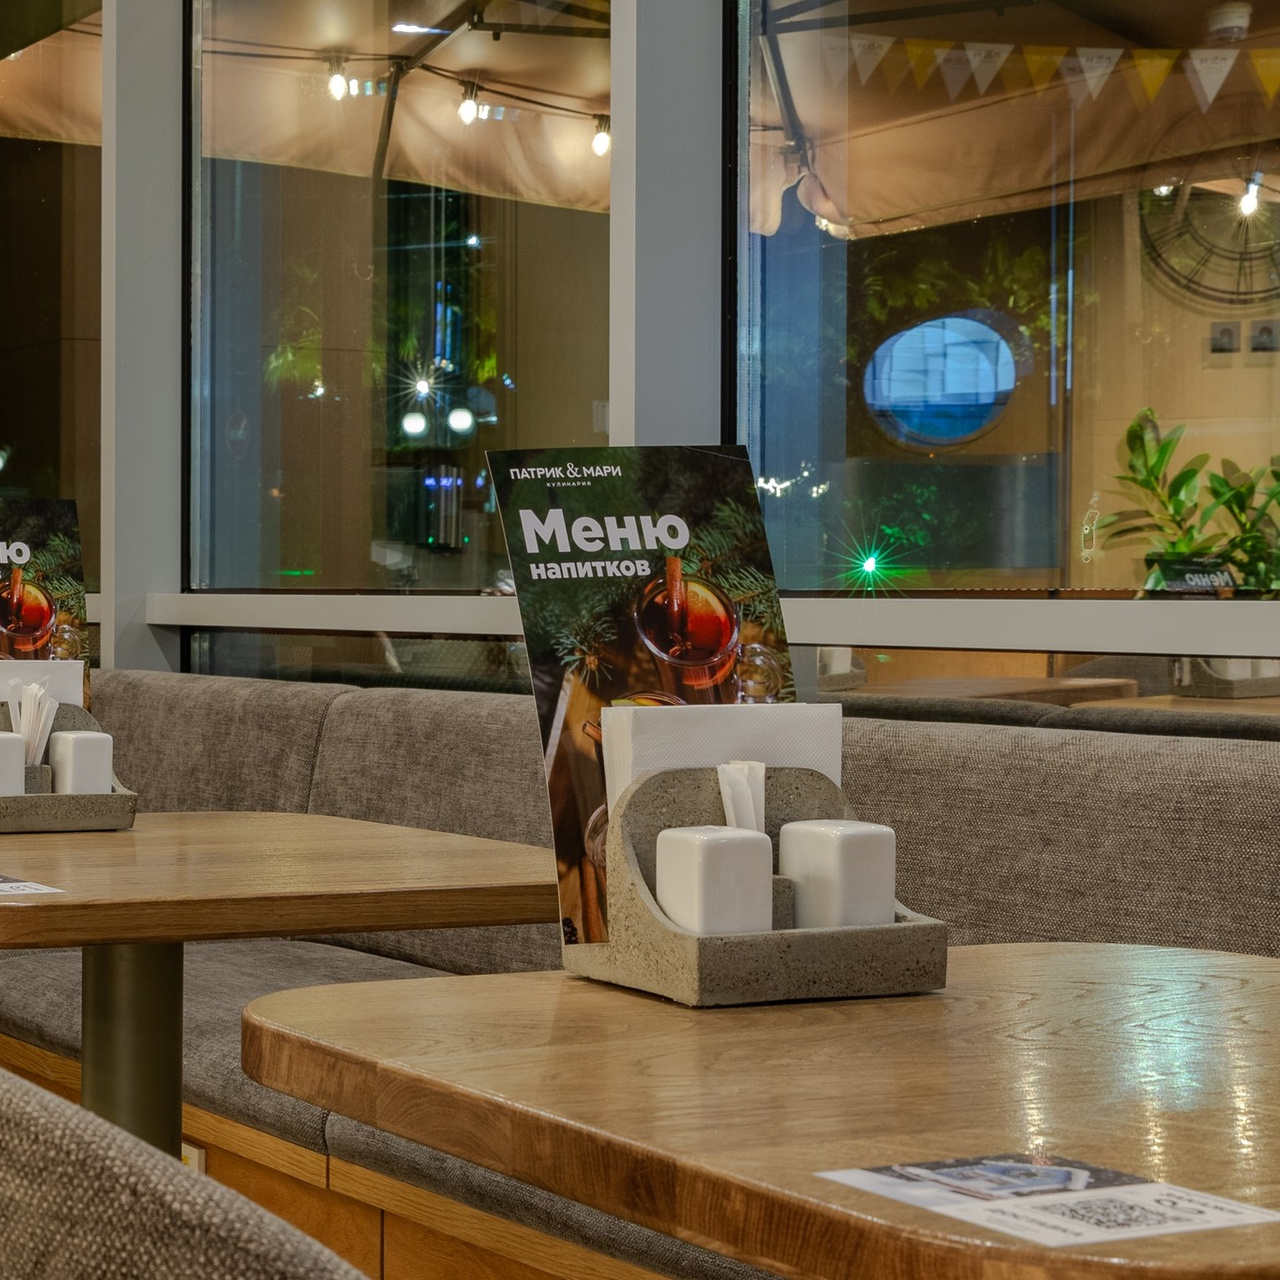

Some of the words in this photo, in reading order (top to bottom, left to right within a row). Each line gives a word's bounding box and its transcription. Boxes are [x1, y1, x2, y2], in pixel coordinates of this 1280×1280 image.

[509, 466, 565, 480] ПАТРИК
[566, 462, 582, 478] &
[582, 465, 622, 477] МАРИ
[518, 508, 690, 554] Меню
[529, 559, 651, 580] напитков
